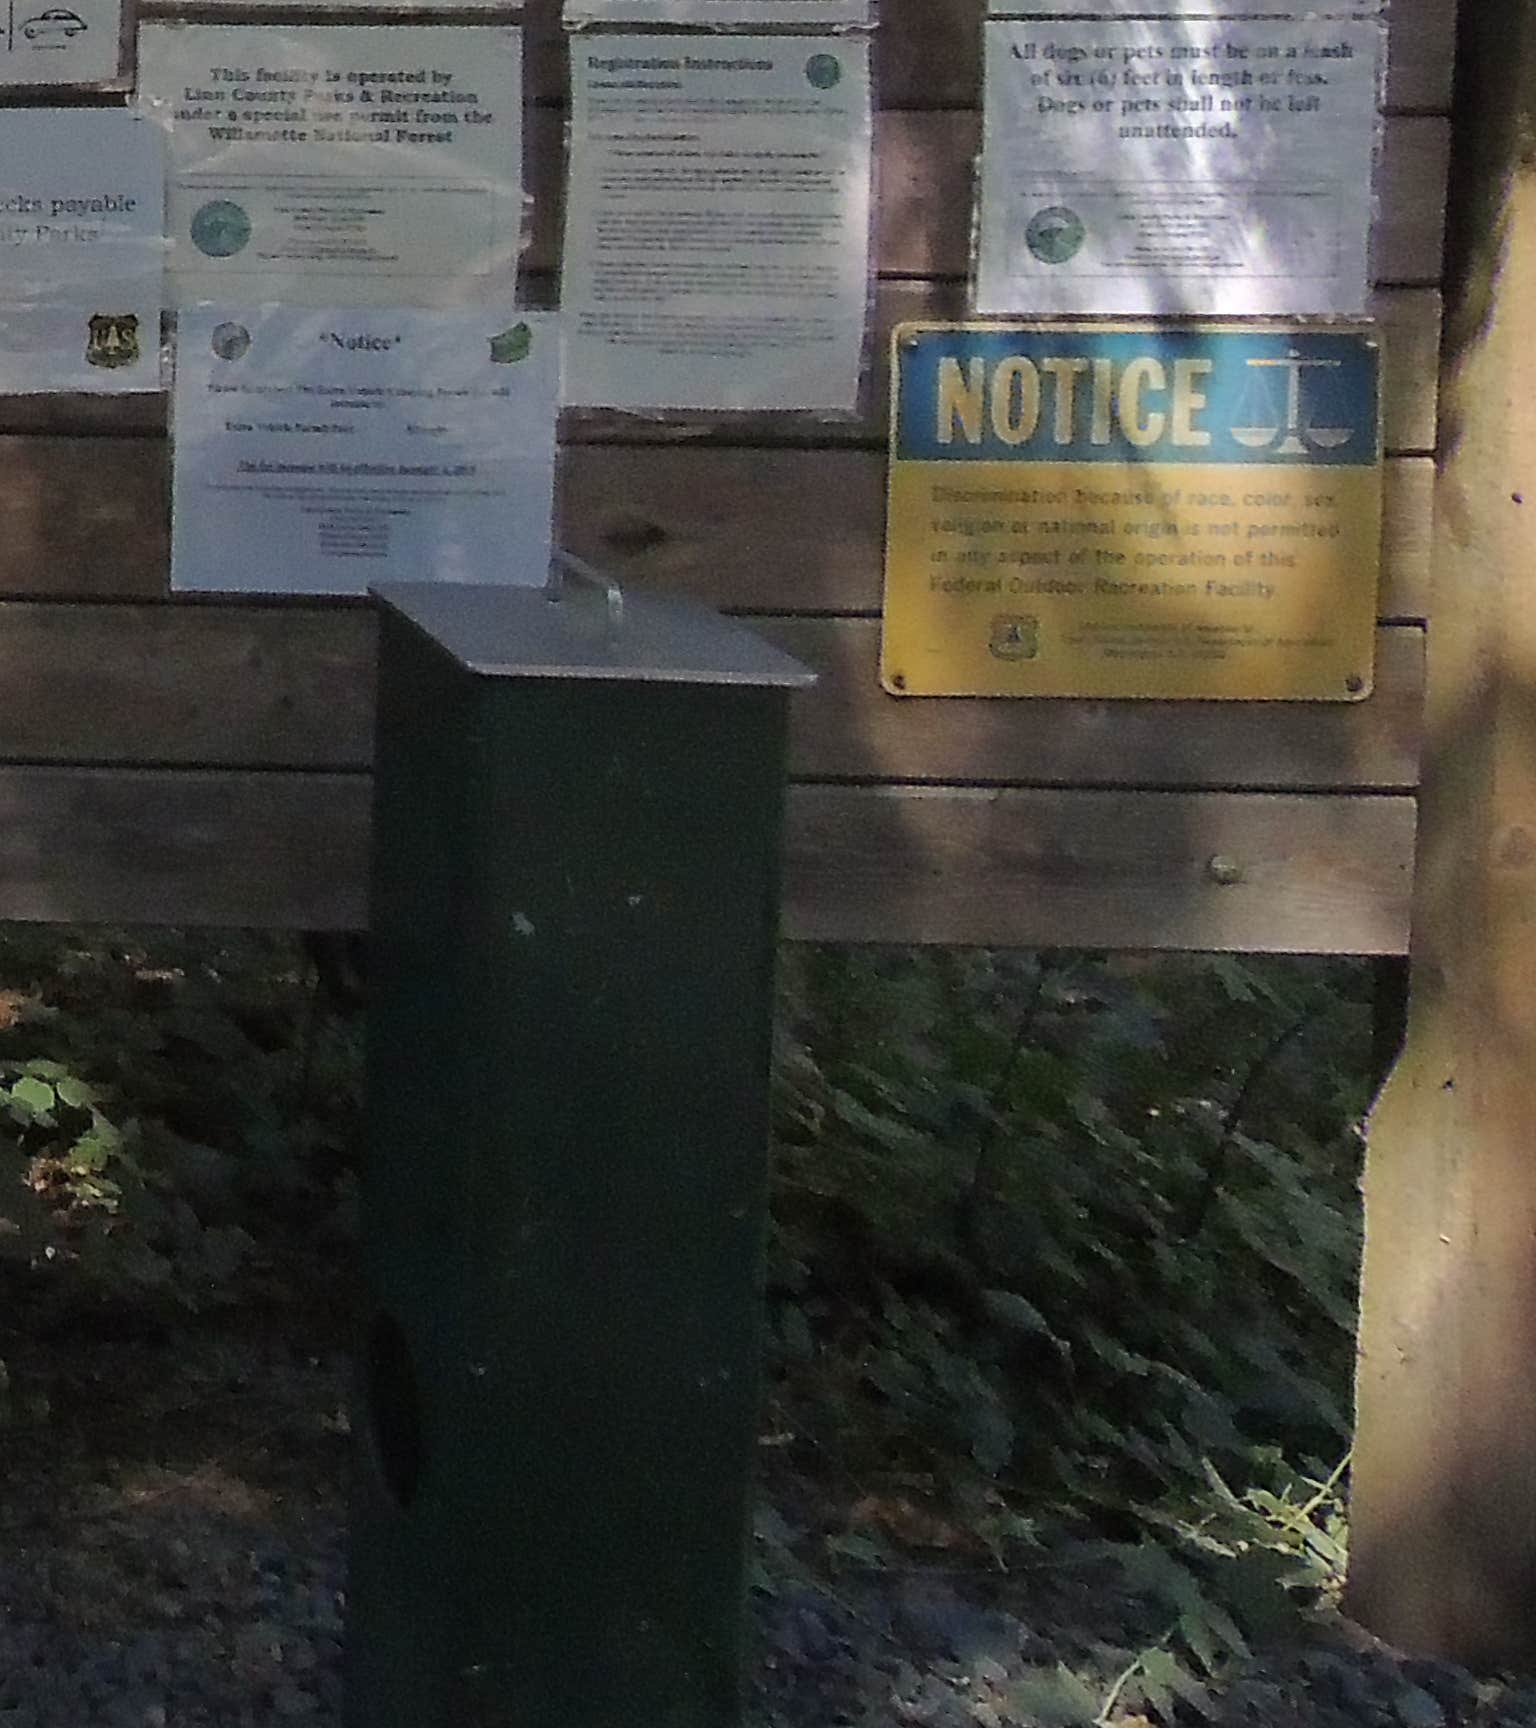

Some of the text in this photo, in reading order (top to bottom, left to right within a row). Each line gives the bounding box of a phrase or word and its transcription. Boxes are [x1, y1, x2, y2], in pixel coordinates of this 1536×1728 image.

[1123, 44, 1164, 64] pets
[347, 70, 425, 86] operated
[432, 70, 453, 88] by
[184, 88, 226, 103] Linn
[231, 88, 296, 106] County
[416, 110, 458, 124] from
[464, 110, 493, 124] the
[50, 194, 137, 220] payable
[935, 355, 1214, 448] NOTICE
